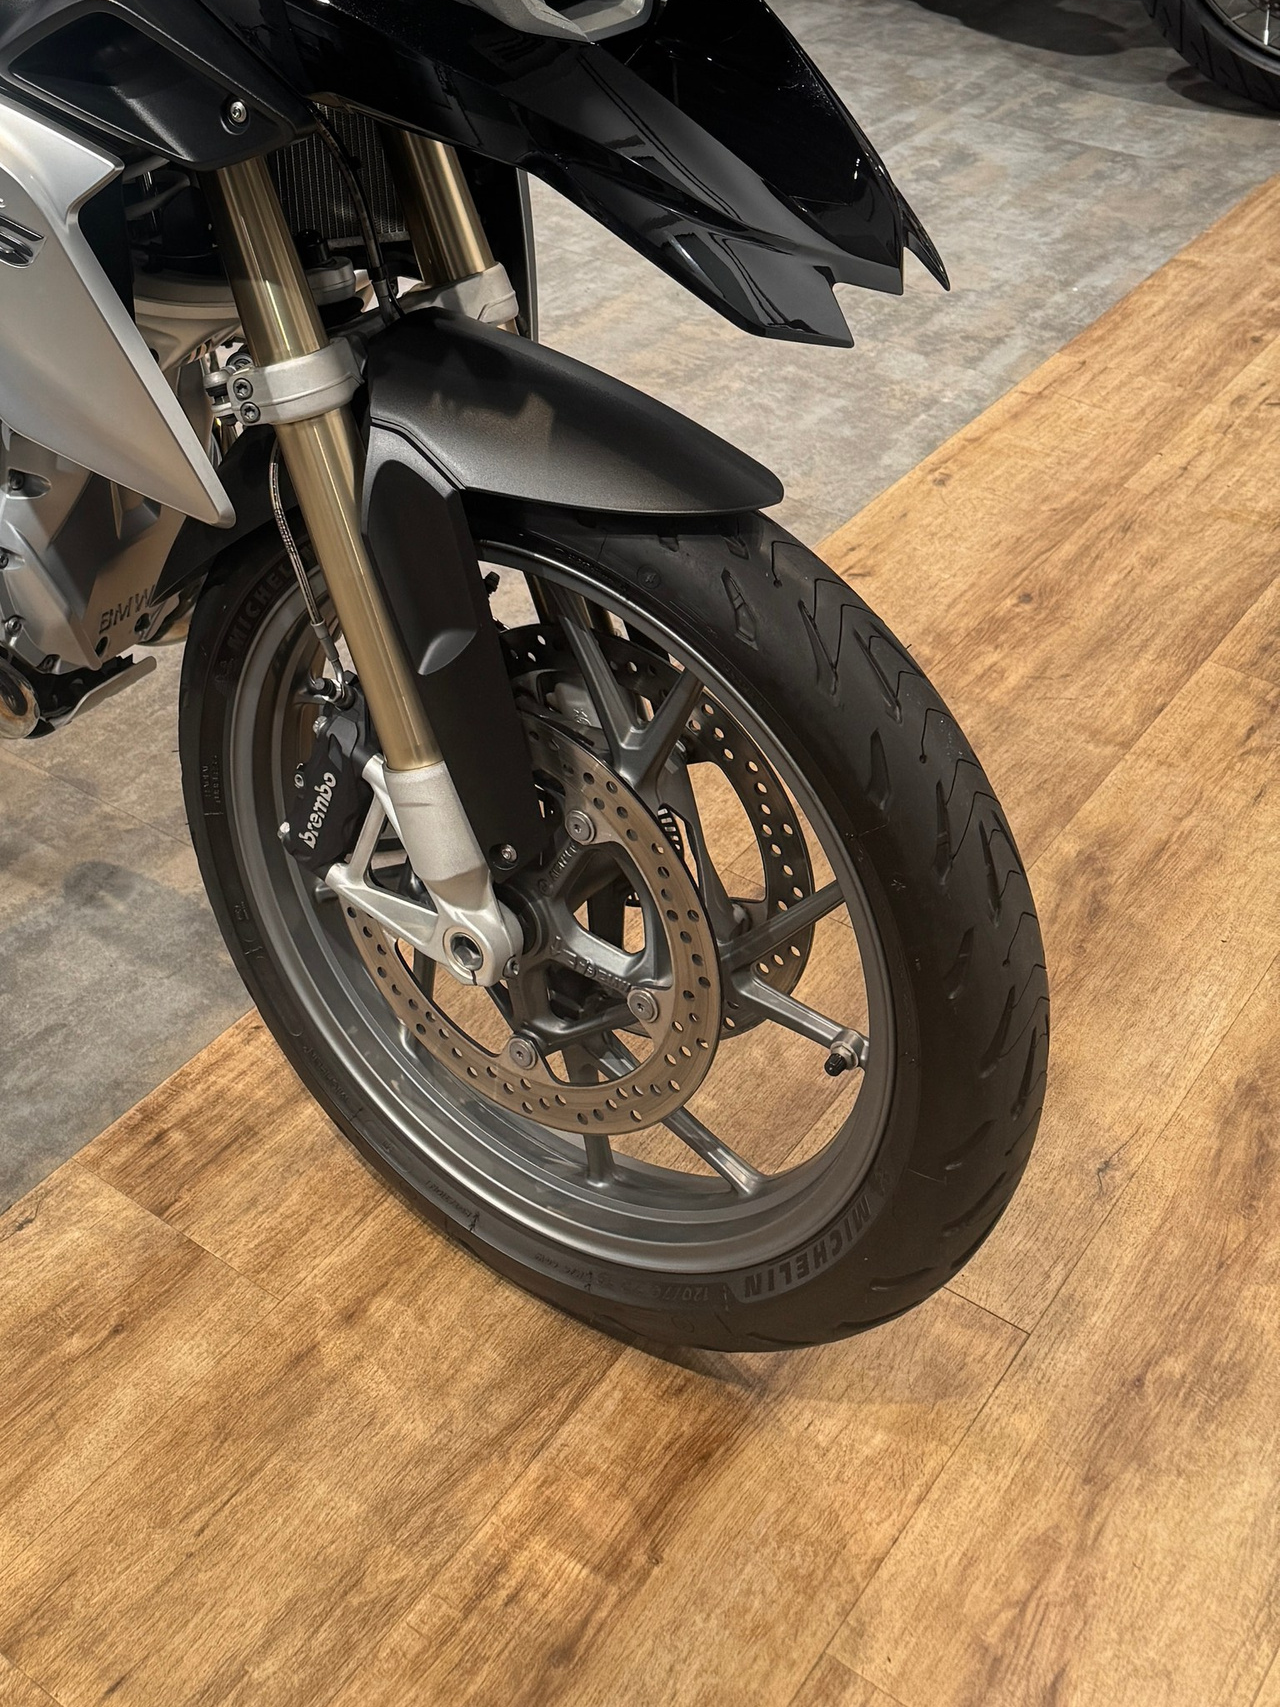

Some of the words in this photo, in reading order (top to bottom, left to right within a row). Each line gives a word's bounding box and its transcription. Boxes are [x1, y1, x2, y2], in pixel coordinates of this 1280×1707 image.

[98, 584, 155, 635] BMW
[298, 771, 337, 850] brembo
[744, 1194, 871, 1299] MICHELIN
